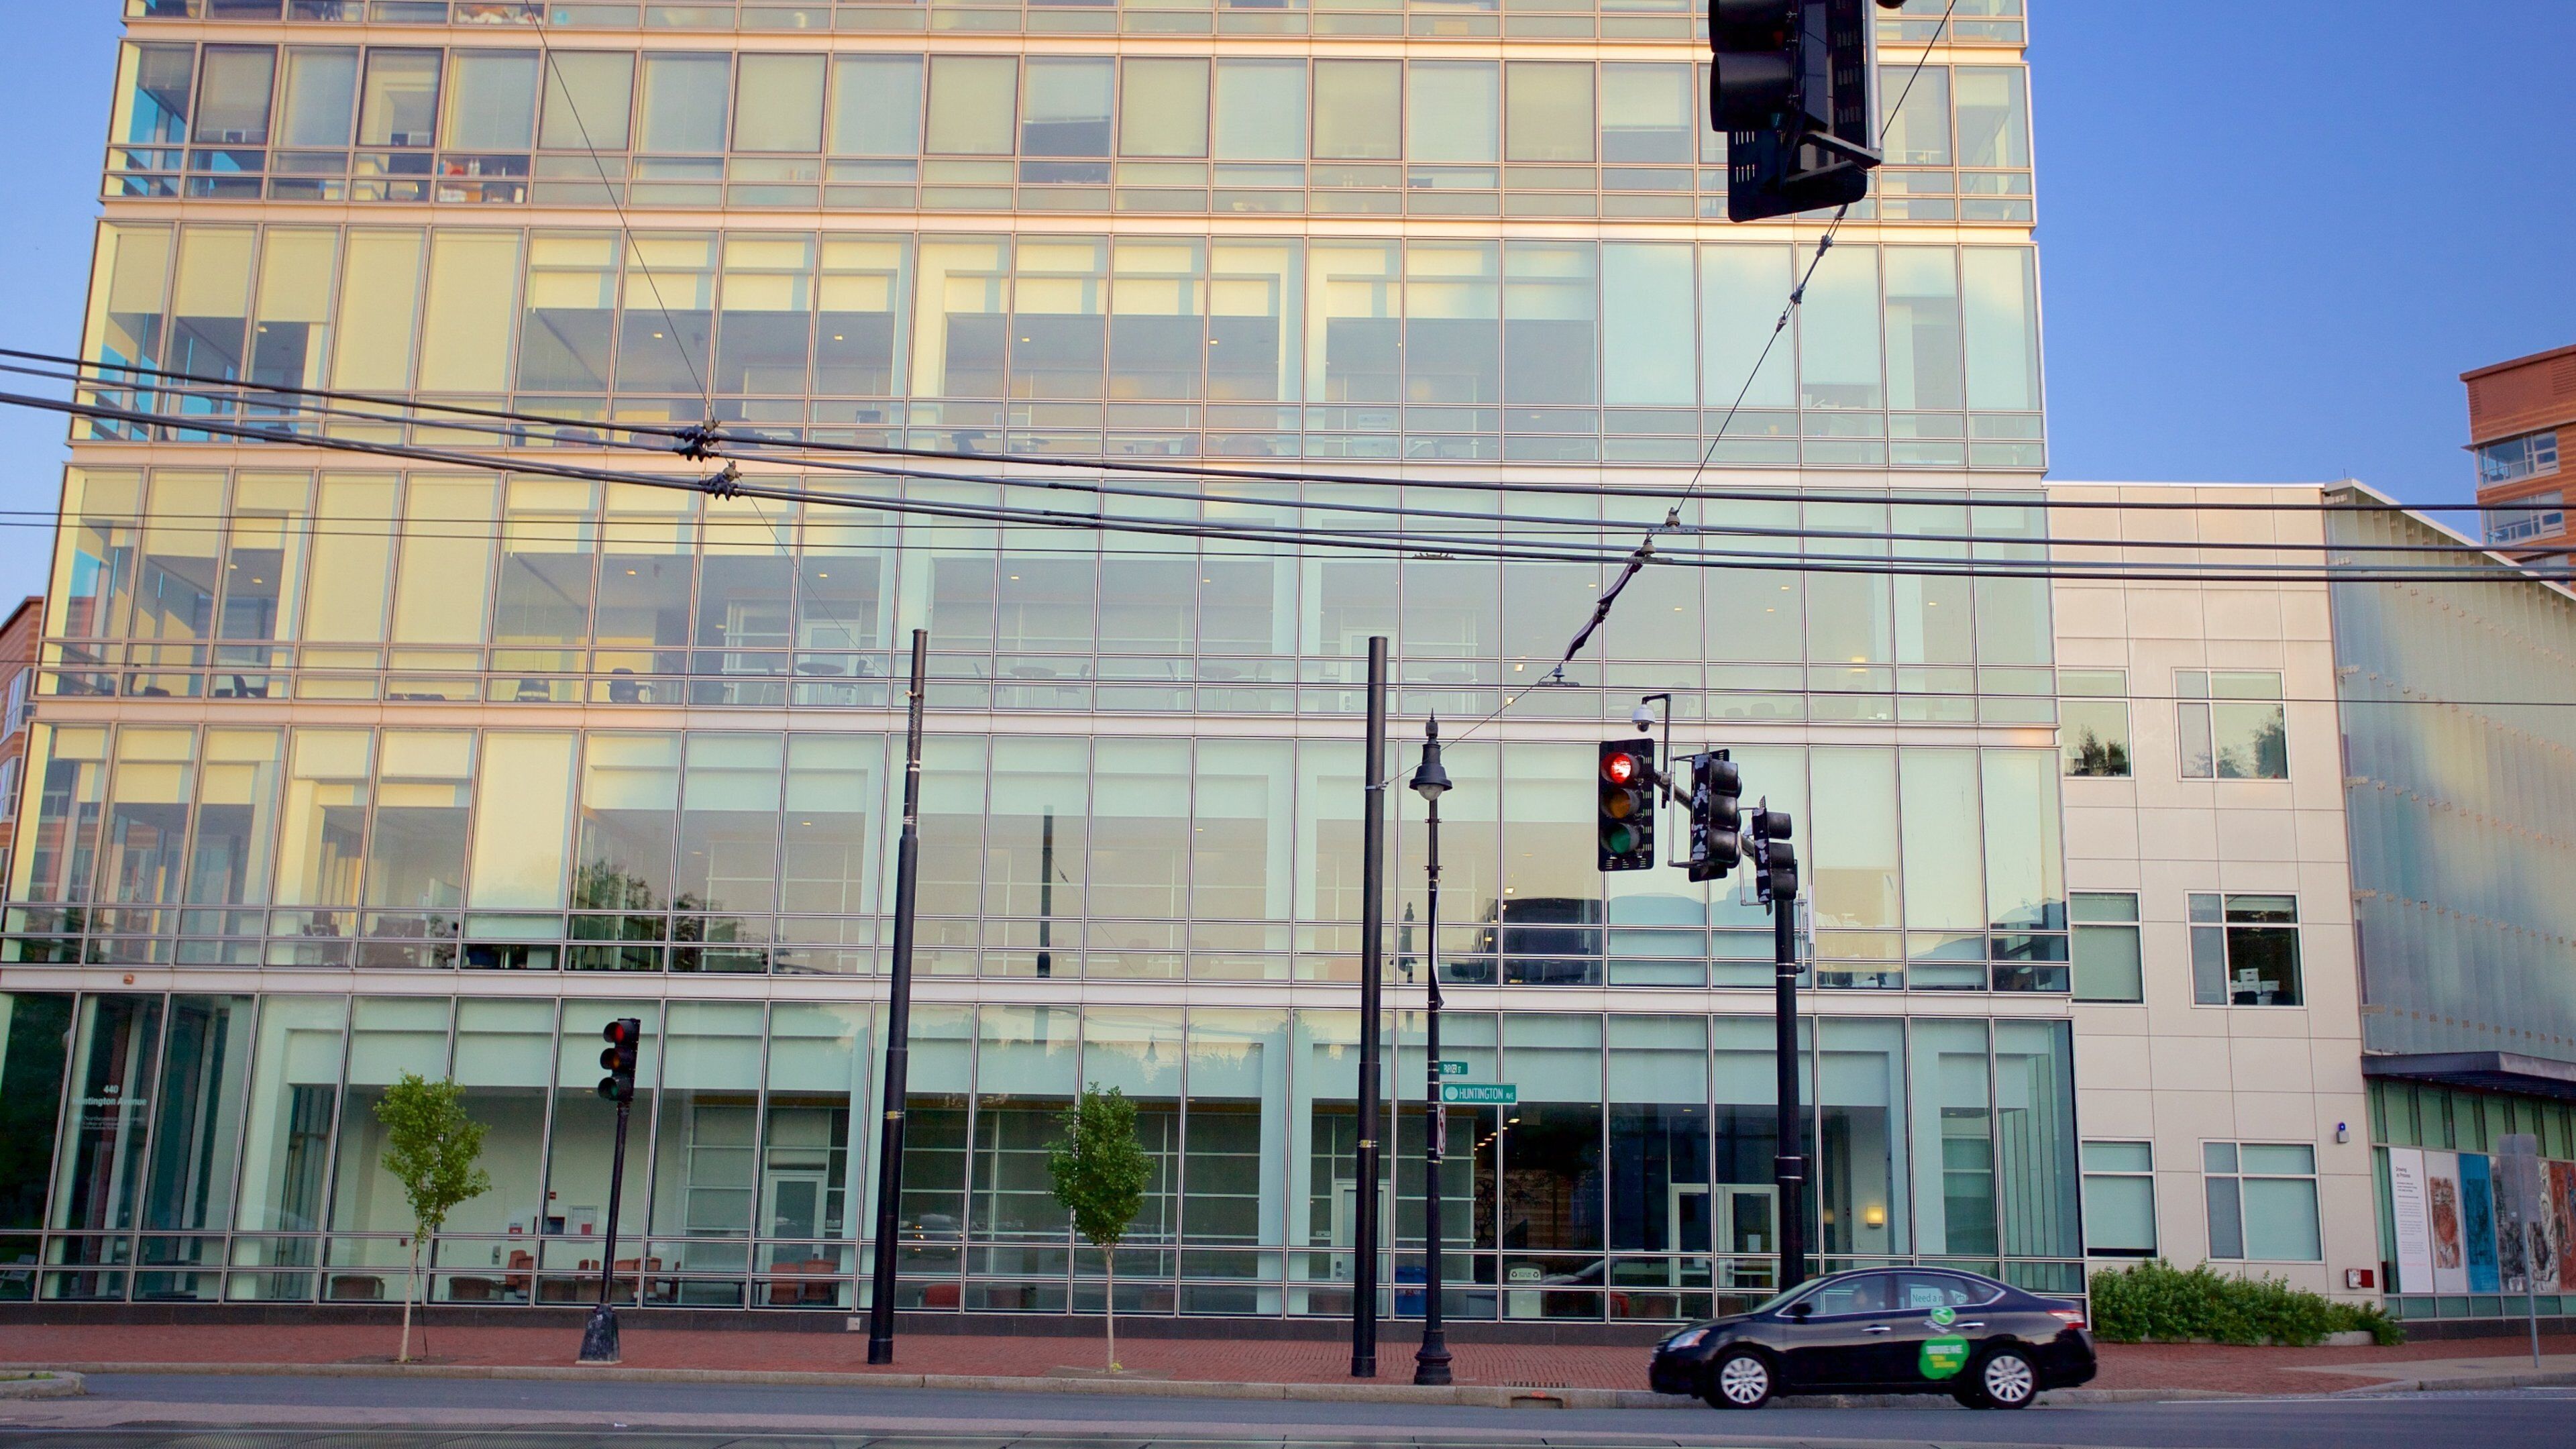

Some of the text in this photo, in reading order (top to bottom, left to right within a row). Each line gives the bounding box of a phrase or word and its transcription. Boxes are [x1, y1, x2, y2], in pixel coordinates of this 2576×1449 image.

[1444, 1064, 1458, 1073] PARKER
[103, 1085, 119, 1093] 440
[1459, 1087, 1503, 1099] HUNTINGTON
[72, 1097, 147, 1107] Huntington Avenue
[1913, 1293, 1931, 1302] Need
